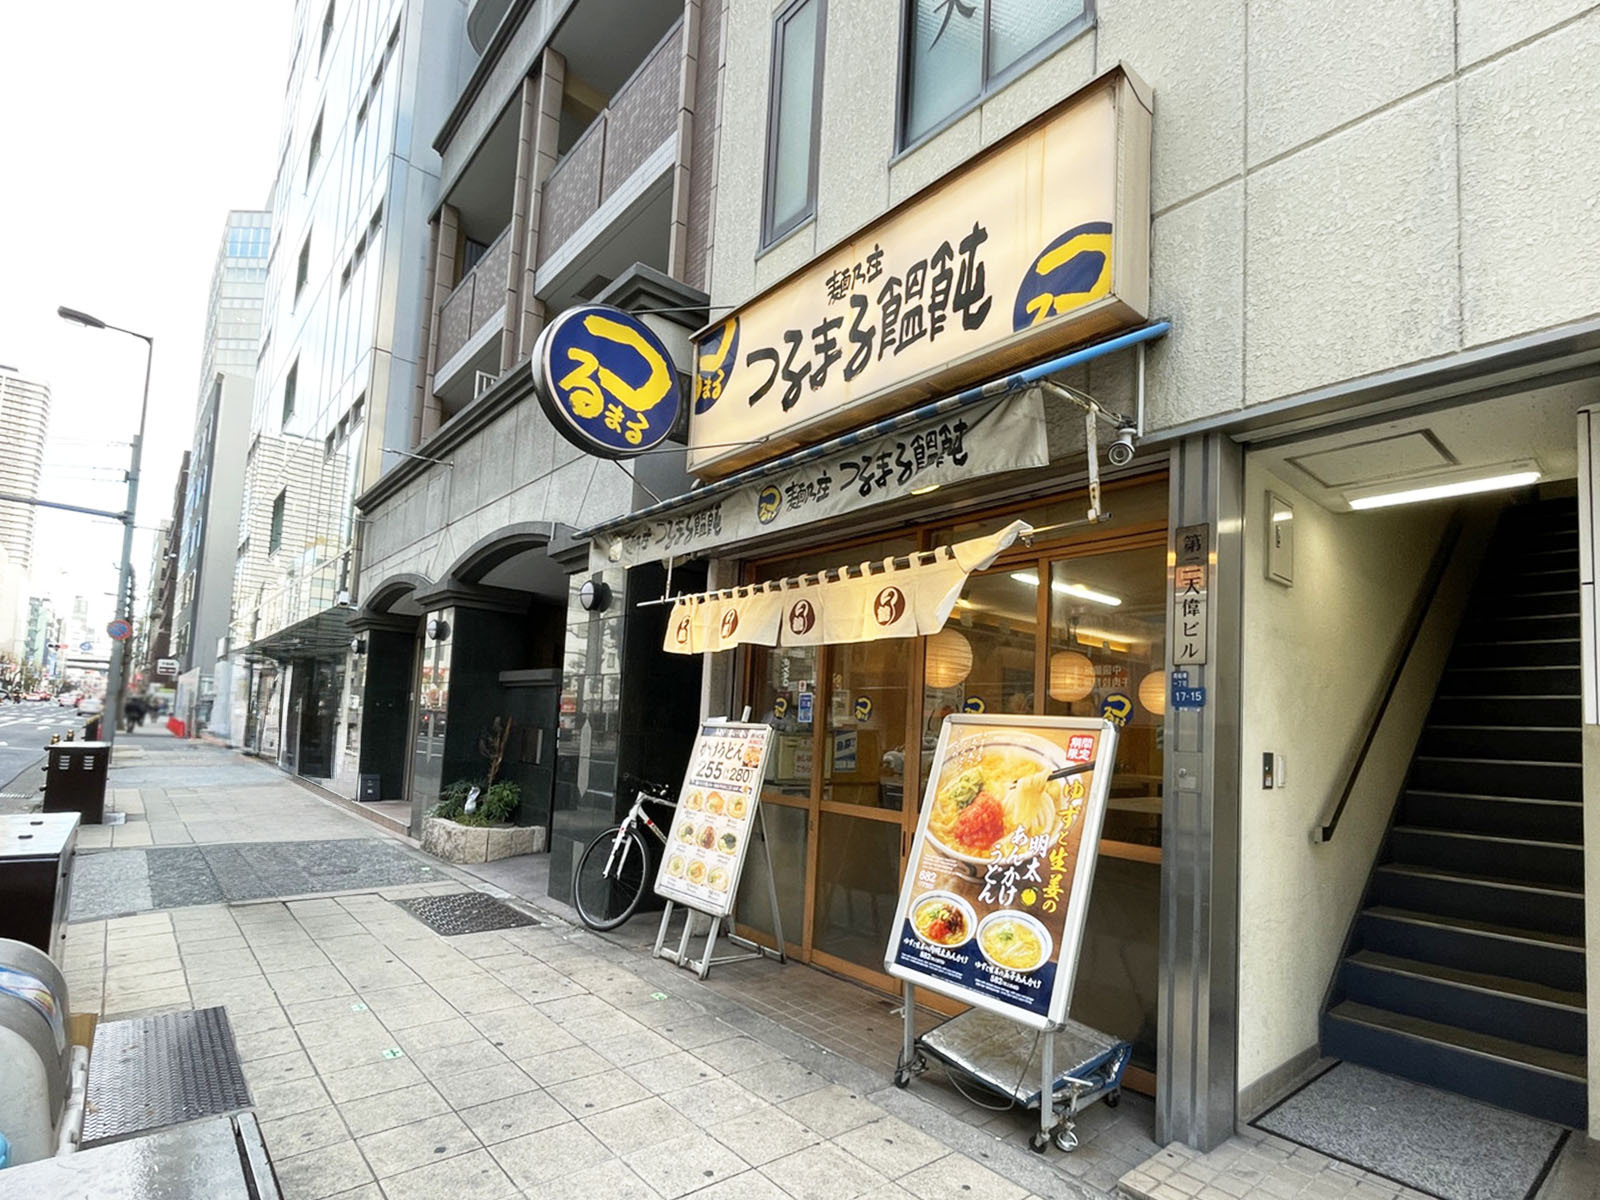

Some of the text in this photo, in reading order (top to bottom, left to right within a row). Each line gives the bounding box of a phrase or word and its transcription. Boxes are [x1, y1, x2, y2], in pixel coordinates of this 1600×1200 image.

[746, 221, 993, 412] つるまる饂飩
[839, 418, 969, 497] つるまる饂飩
[696, 760, 724, 780] 255
[979, 842, 1003, 905] うどん
[998, 824, 1029, 907] あんかけ
[1021, 832, 1050, 884] 明太
[1041, 778, 1085, 914] ゆずと生姜の
